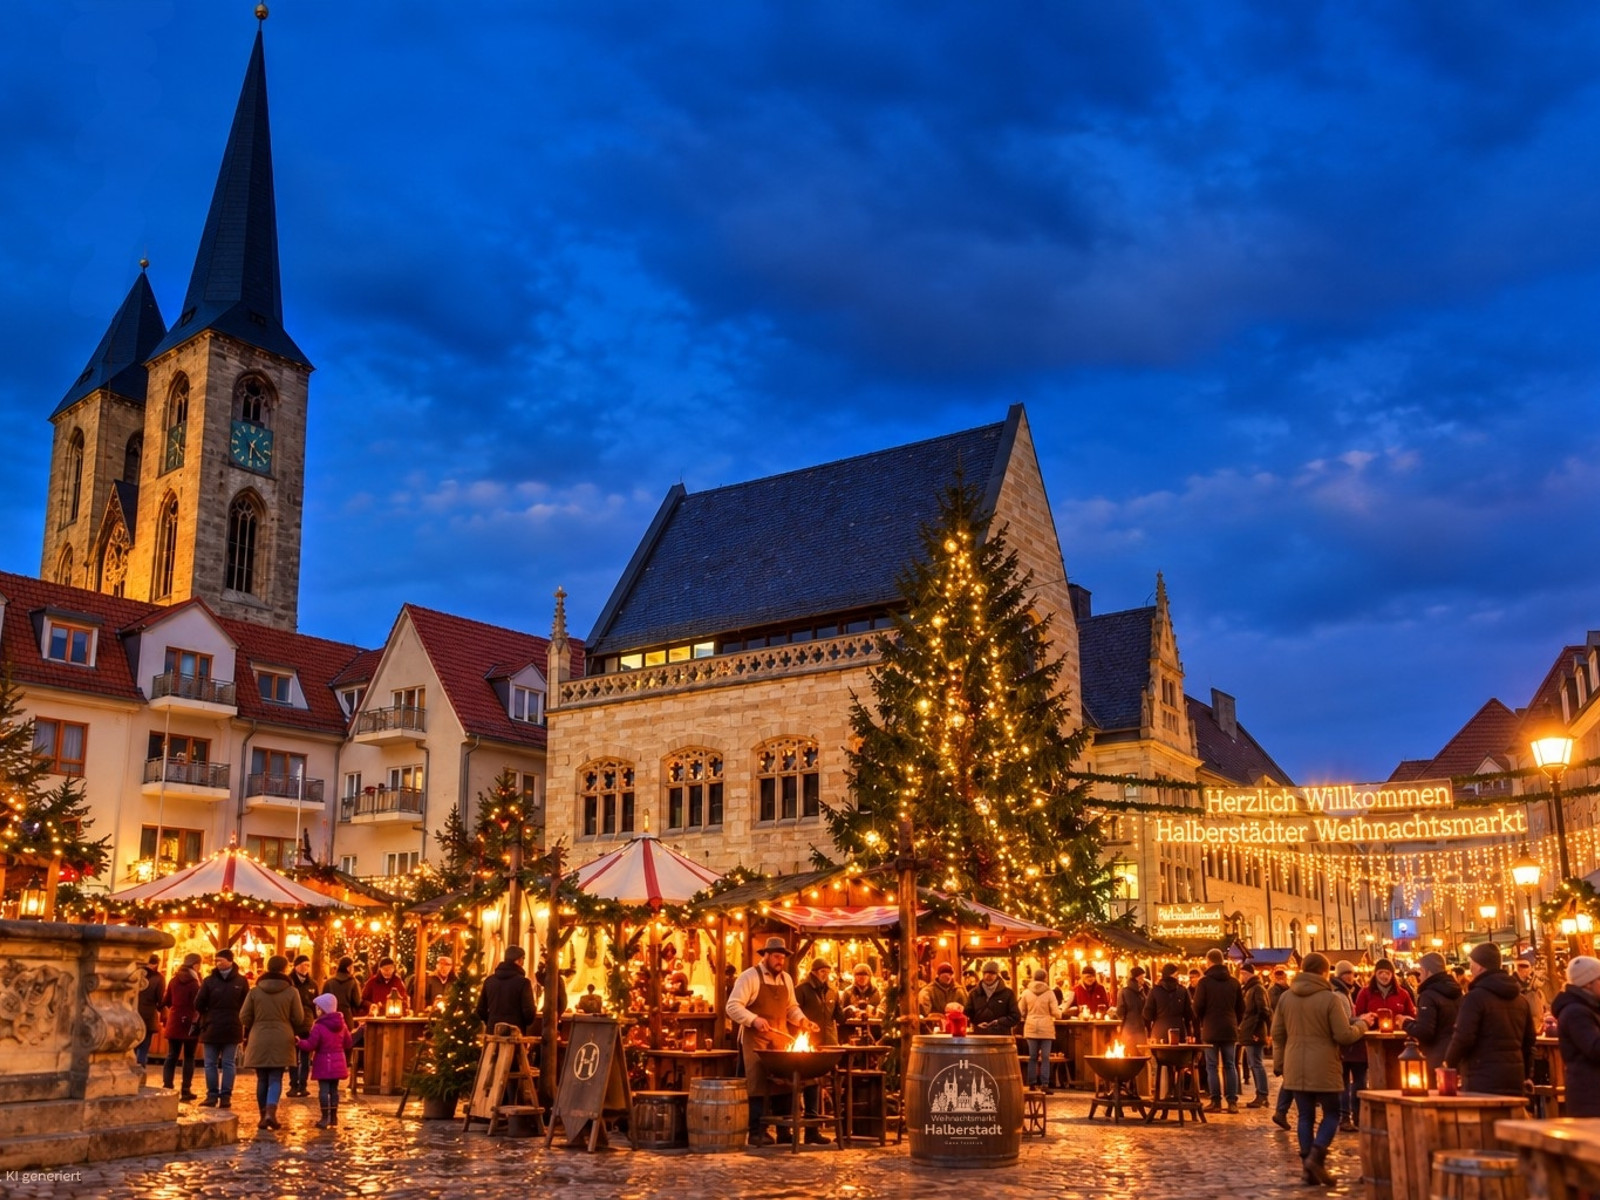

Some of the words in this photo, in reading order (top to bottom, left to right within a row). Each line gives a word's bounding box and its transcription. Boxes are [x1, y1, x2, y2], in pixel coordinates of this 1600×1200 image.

[1206, 787, 1298, 813] Herzlich
[1303, 785, 1451, 812] Willkommen
[1156, 818, 1309, 843] Halberstädter
[1314, 808, 1528, 842] Weihnachtsmarkt
[931, 1114, 996, 1122] Weihnachtsmarkt
[925, 1123, 1003, 1136] Halberstadt
